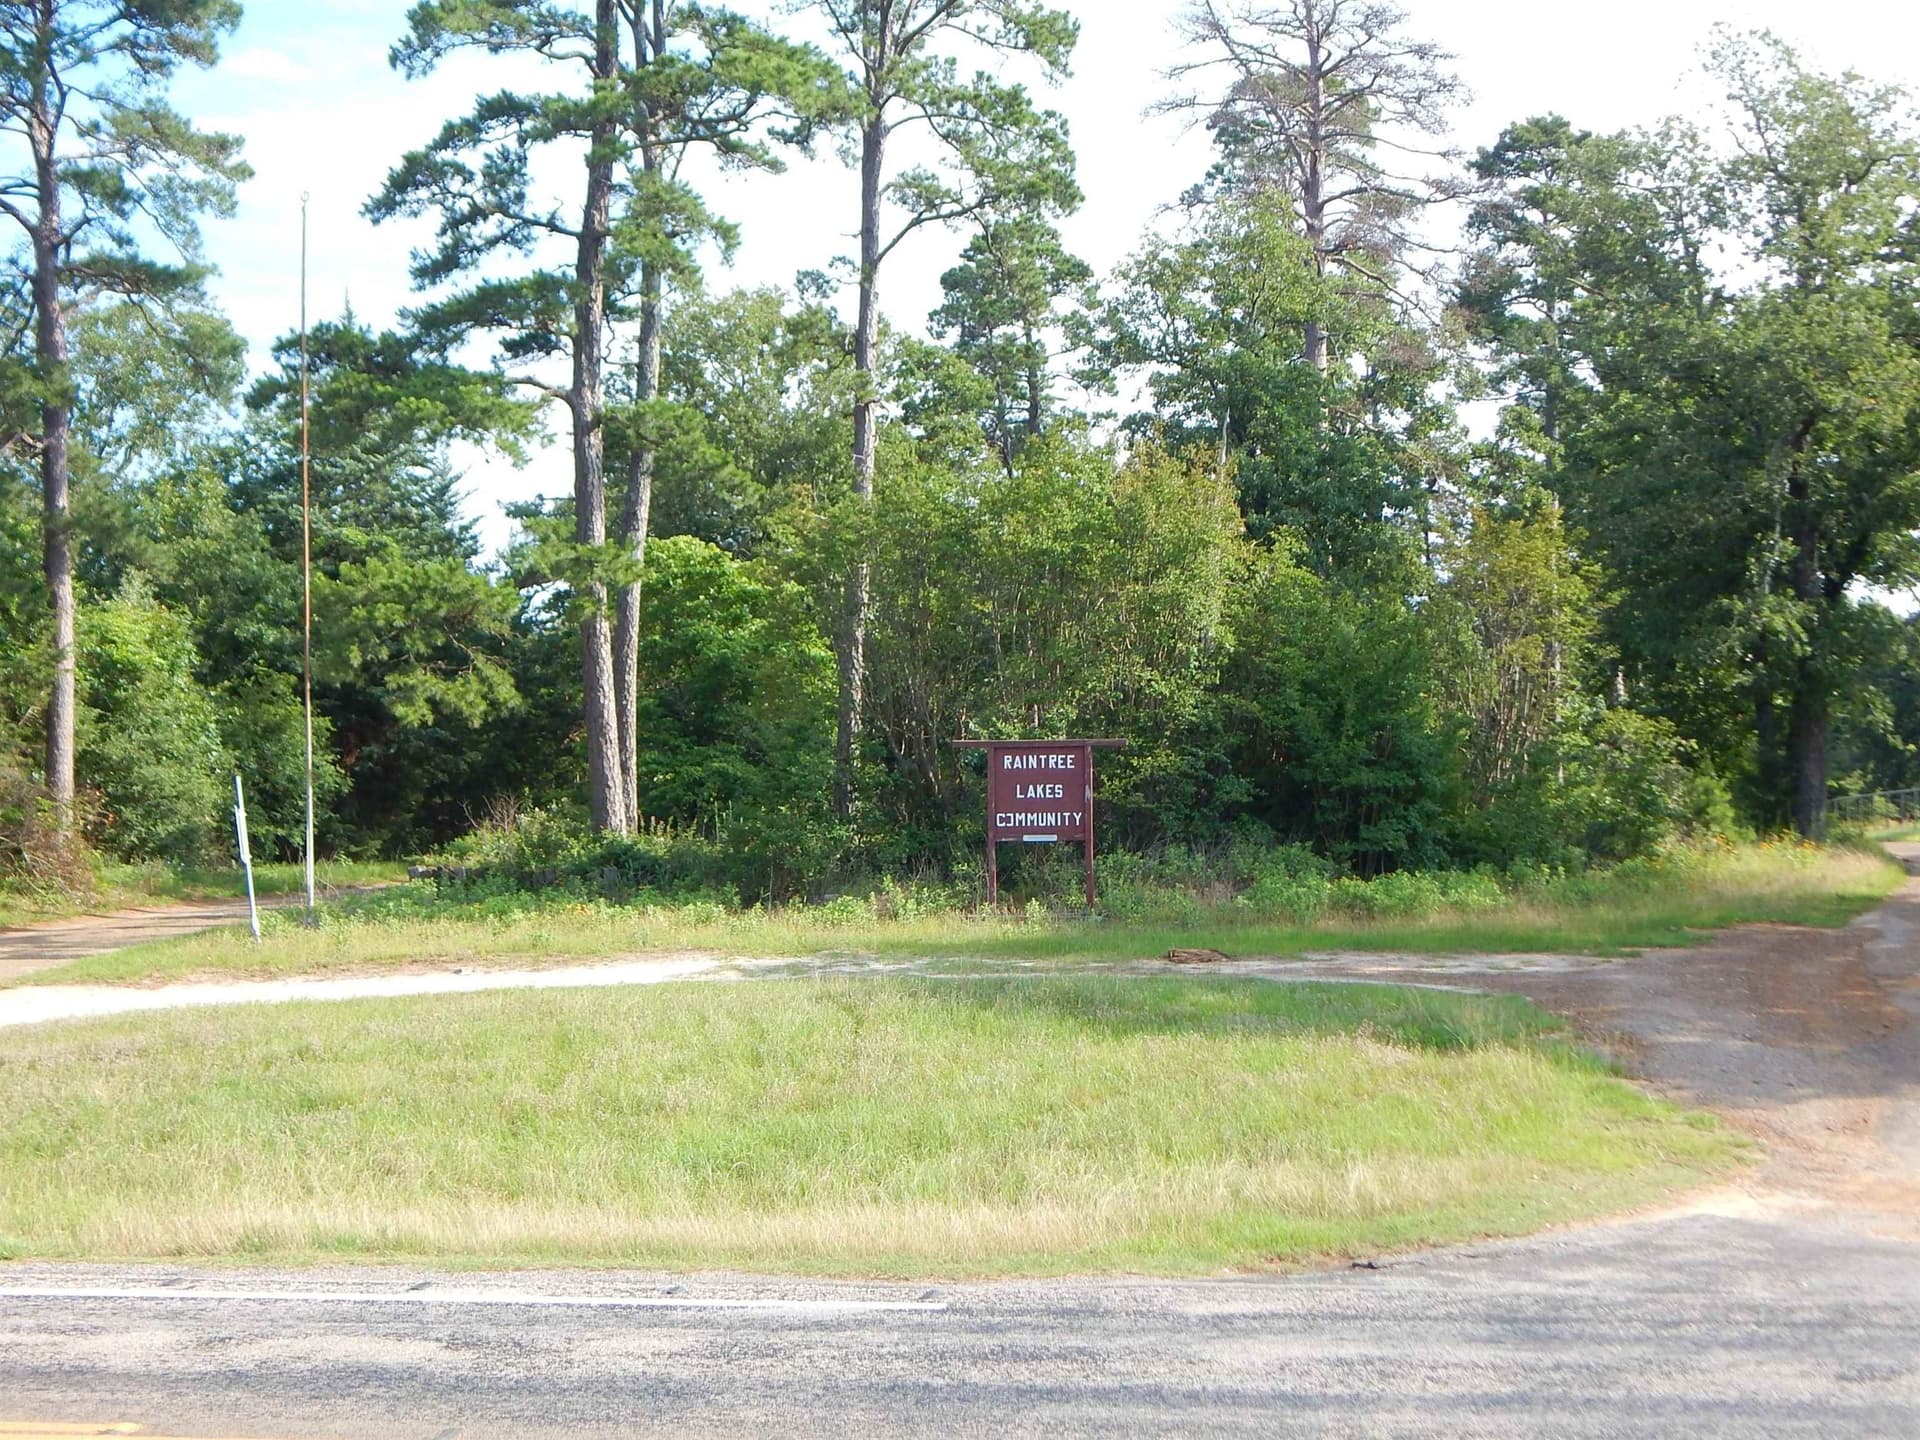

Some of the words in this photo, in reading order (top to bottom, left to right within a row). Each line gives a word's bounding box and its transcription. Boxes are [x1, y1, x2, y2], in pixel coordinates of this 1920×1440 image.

[1004, 755, 1075, 769] RAINTREE
[1016, 784, 1063, 798] LAKES
[996, 812, 1082, 827] COMMUNITY
